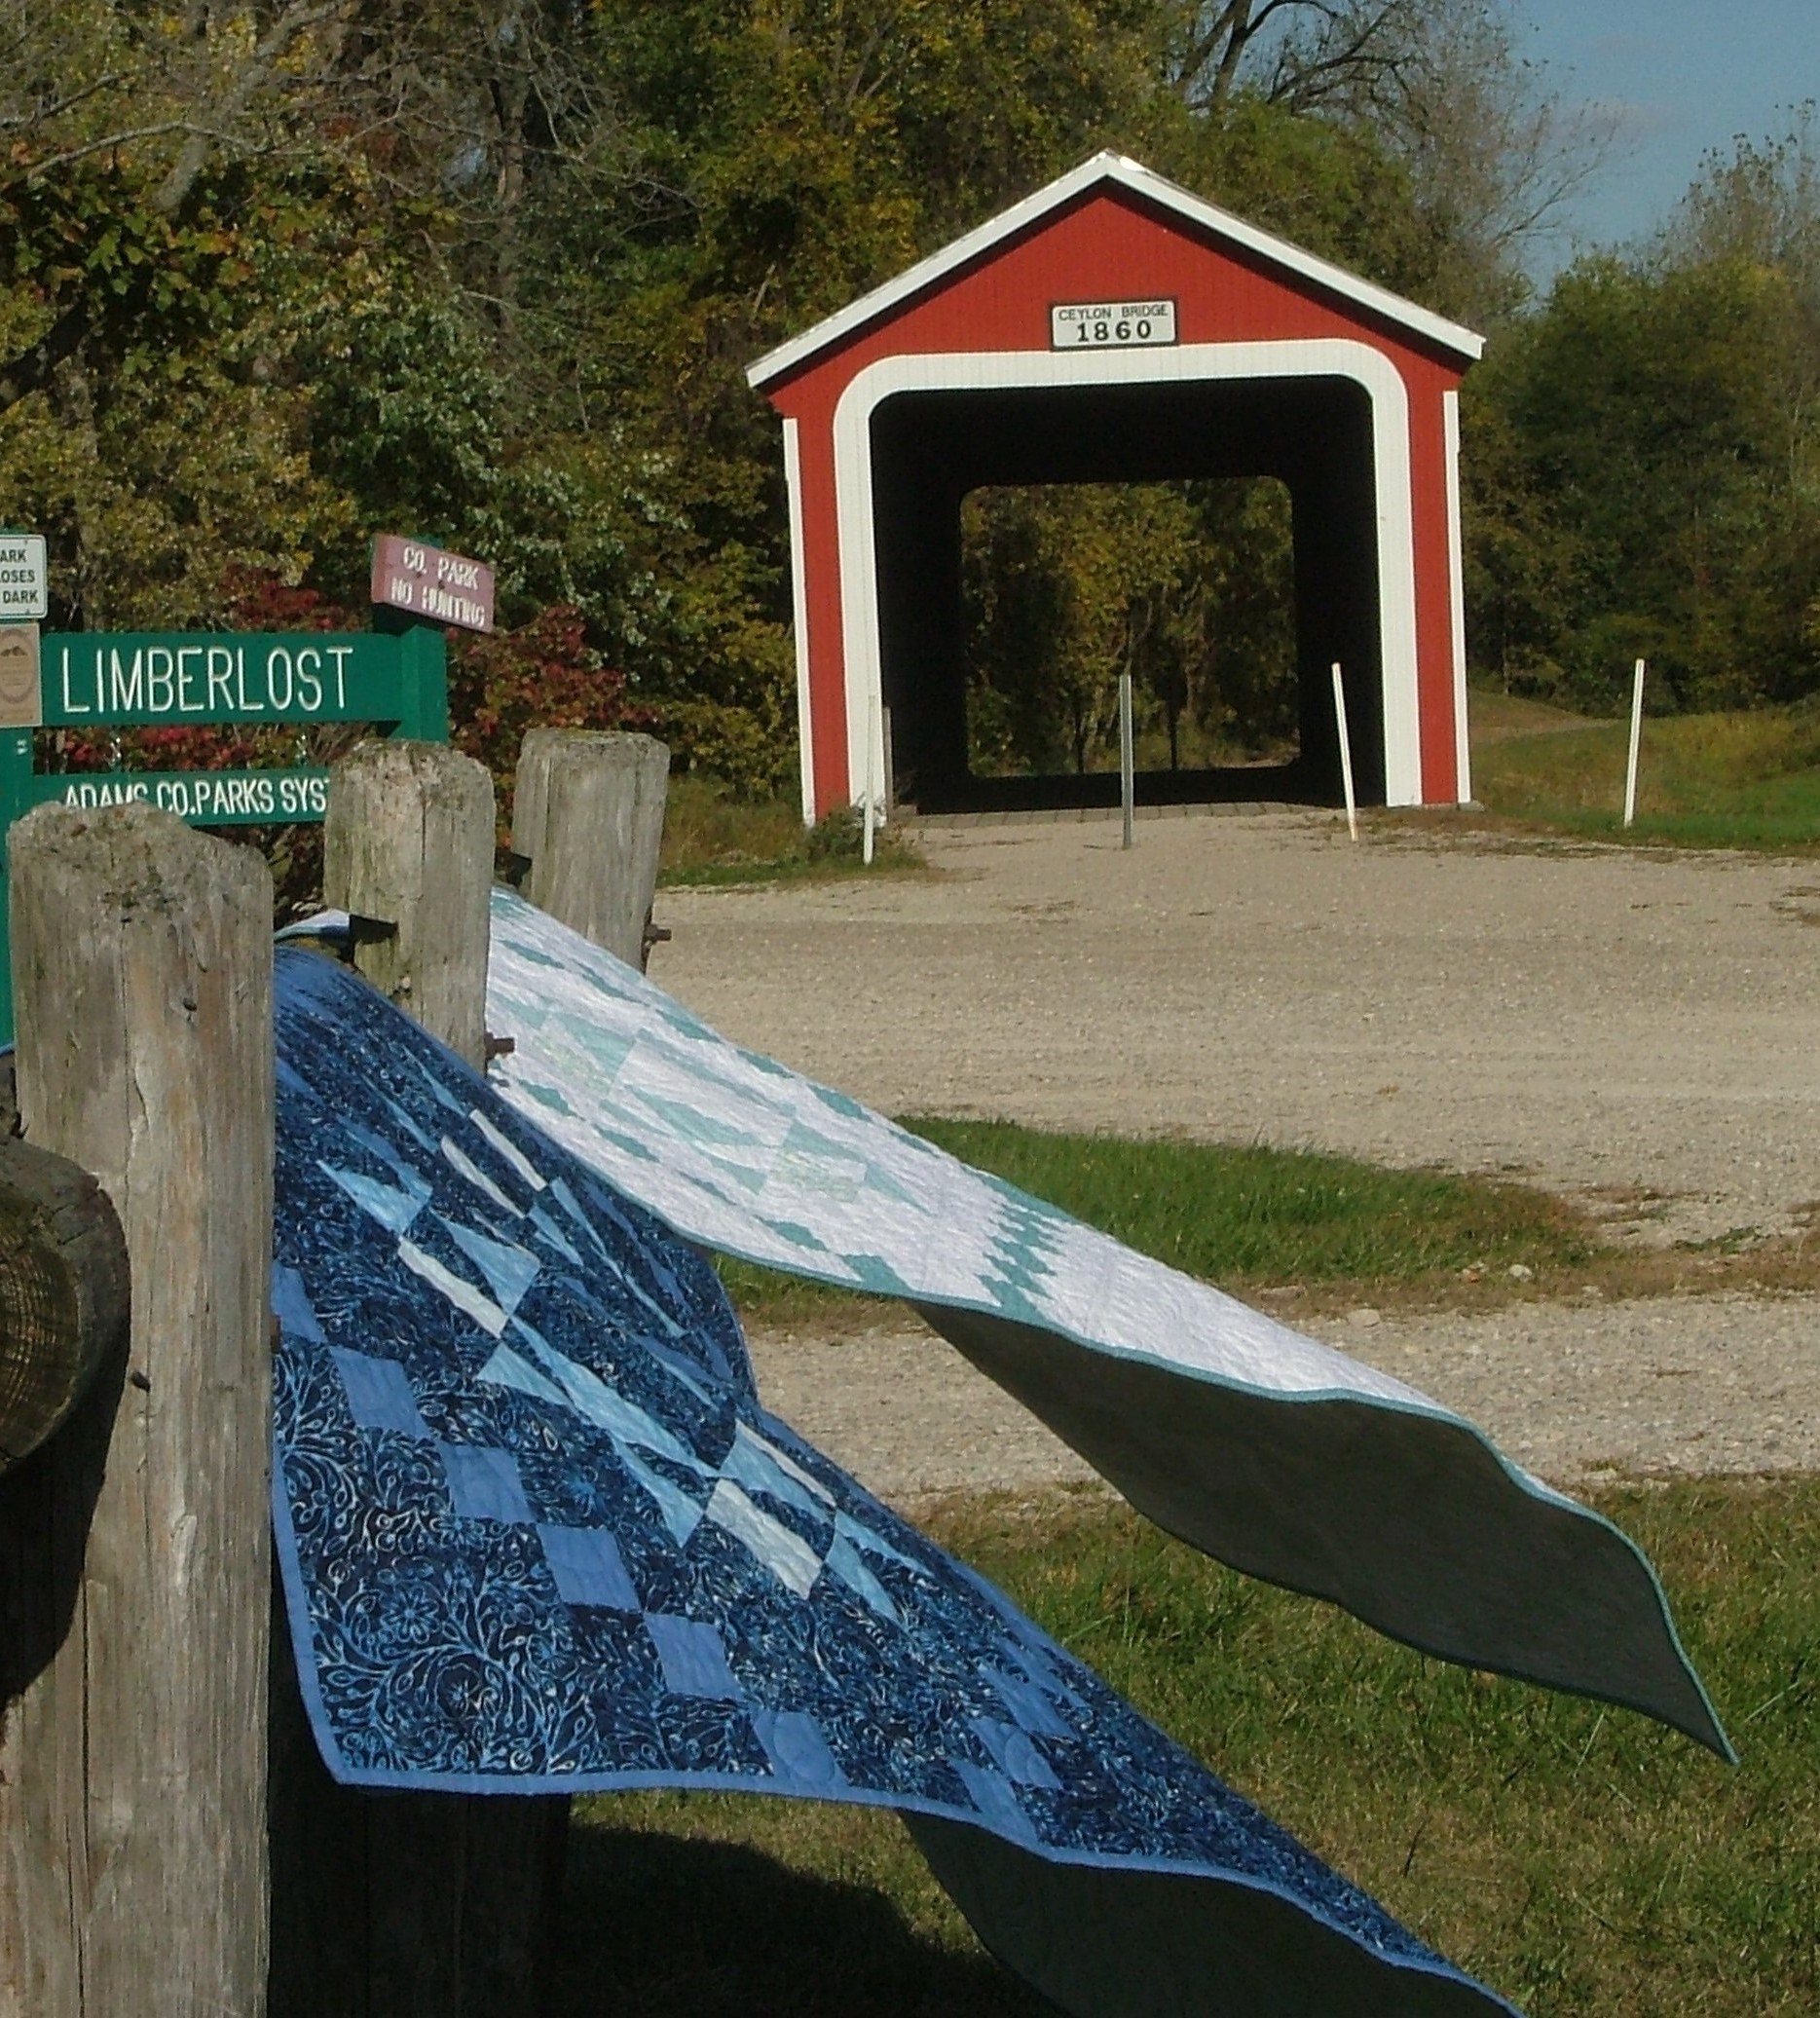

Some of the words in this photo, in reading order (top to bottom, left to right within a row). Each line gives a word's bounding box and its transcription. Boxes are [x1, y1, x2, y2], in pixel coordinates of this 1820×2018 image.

[1058, 306, 1112, 321] CEYLON
[1121, 304, 1169, 318] BRIDGE
[1077, 319, 1152, 342] 1860
[0, 548, 27, 563] ARK
[0, 569, 36, 583] OSES
[403, 545, 427, 575] CO.
[436, 555, 480, 590] PARK
[3, 589, 39, 604] DARK
[390, 576, 413, 605] NO
[421, 584, 486, 628] HUNTING
[61, 647, 353, 714] LIMBERLOST
[279, 777, 330, 814] SYS
